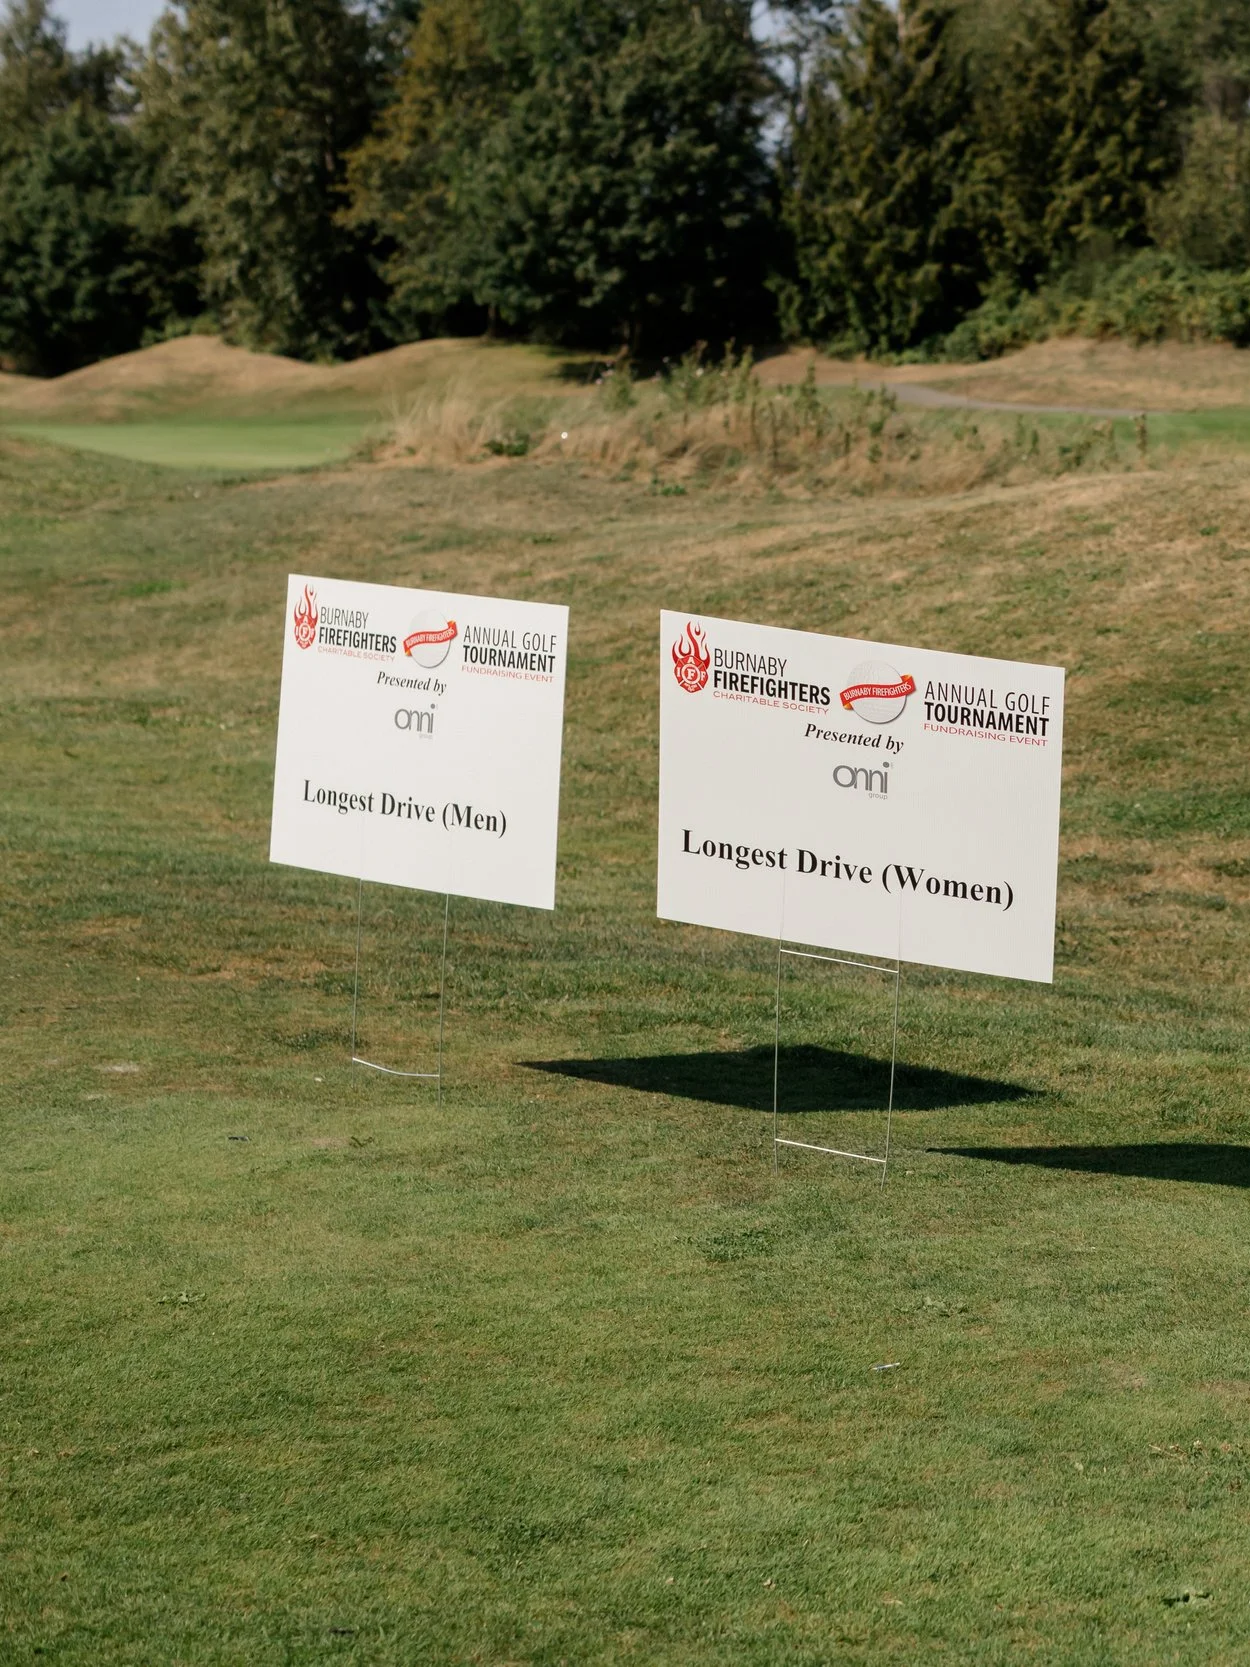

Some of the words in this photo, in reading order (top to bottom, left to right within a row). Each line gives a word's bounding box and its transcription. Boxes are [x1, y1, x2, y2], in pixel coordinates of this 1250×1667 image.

[320, 607, 369, 629] BURNABY
[319, 627, 396, 653] FIREFIGHTERS
[464, 625, 517, 648] ANNUAL
[523, 632, 557, 652] GOLF
[318, 646, 360, 659] CHARITABLE
[362, 651, 395, 662] SOCIETY
[463, 645, 555, 673] TOURNAMENT
[714, 648, 787, 677] BURNABY
[377, 671, 430, 692] Presented
[433, 678, 447, 696] by
[461, 665, 522, 680] FUNDRAISING
[525, 673, 554, 682] EVENT
[713, 671, 830, 705] FIREFIGHTERS
[844, 687, 872, 701] BURNABY
[872, 682, 912, 696] FIREFIGHTERS
[925, 681, 998, 709] ANNUAL
[1005, 692, 1050, 714] GOLF
[713, 691, 780, 709] CHARITABLE
[782, 701, 829, 715] SOCIETY
[924, 702, 1049, 736] TOURNAMENT
[805, 724, 881, 750] Presented
[885, 735, 904, 753] by
[924, 723, 1006, 742] FUNDRAISING
[1009, 735, 1048, 746] EVENT
[833, 762, 890, 793] onni
[304, 780, 373, 814] Longest
[381, 793, 436, 822] Drive
[443, 803, 507, 838] (Men)
[868, 792, 888, 800] group
[681, 829, 788, 870] Longest
[797, 849, 872, 884] Drive
[882, 864, 1014, 911] (Women)
